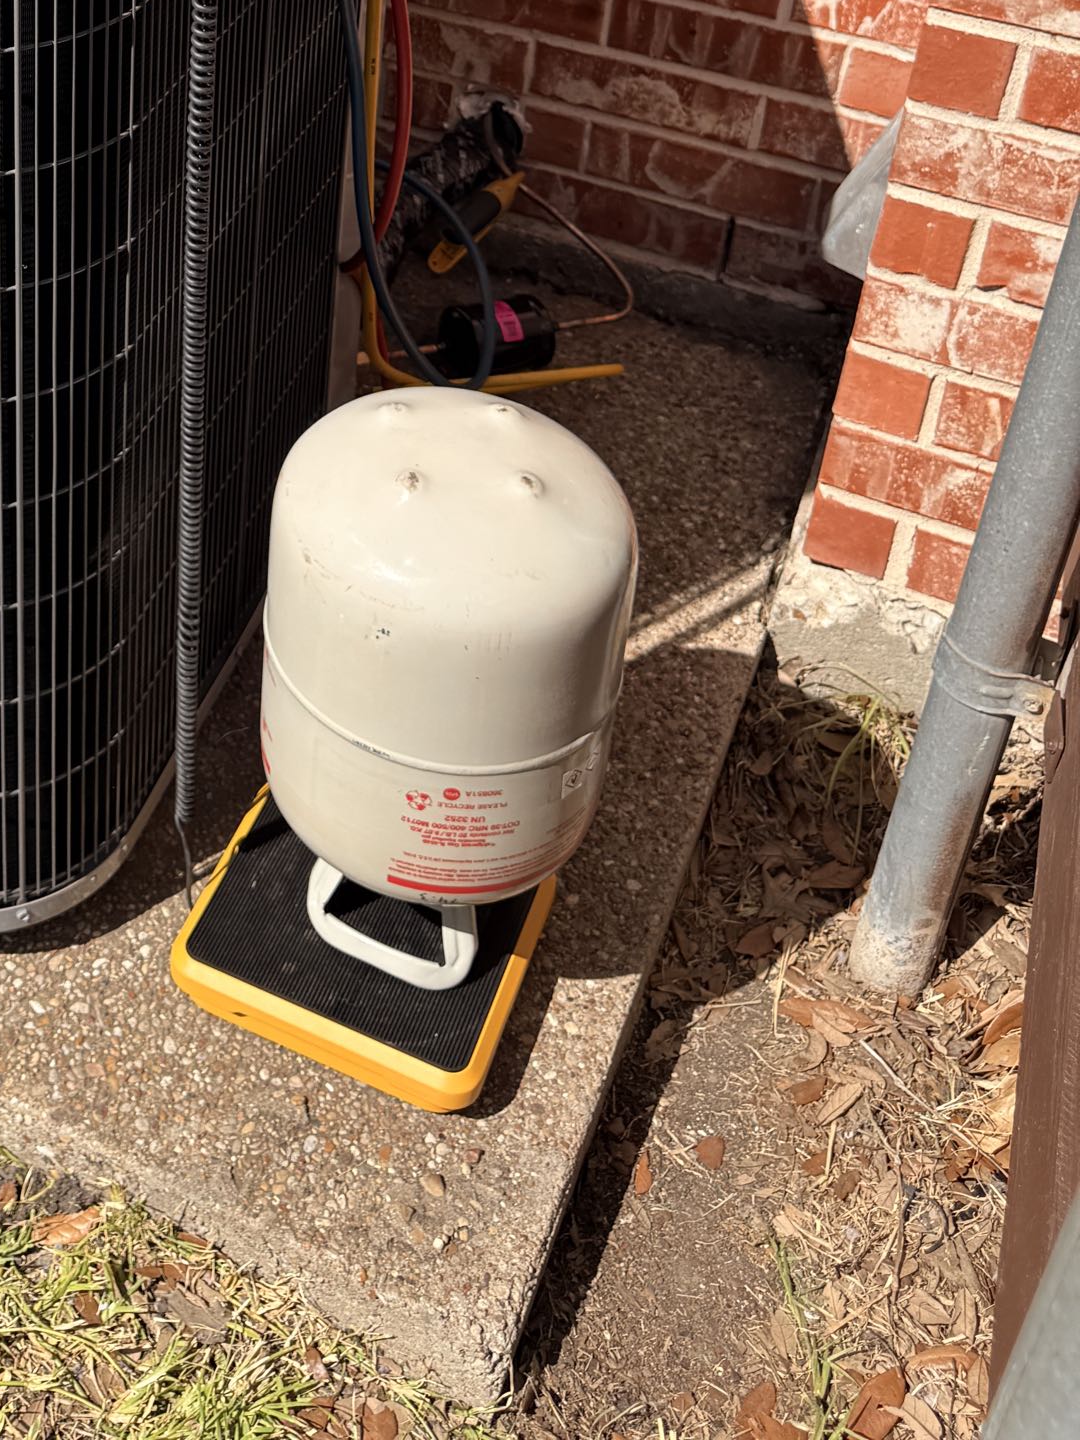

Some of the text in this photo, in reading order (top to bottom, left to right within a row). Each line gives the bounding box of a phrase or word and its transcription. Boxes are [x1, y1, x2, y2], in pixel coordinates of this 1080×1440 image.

[437, 801, 508, 810] PLEASE RECYCLE
[444, 815, 486, 823] UN 3252
